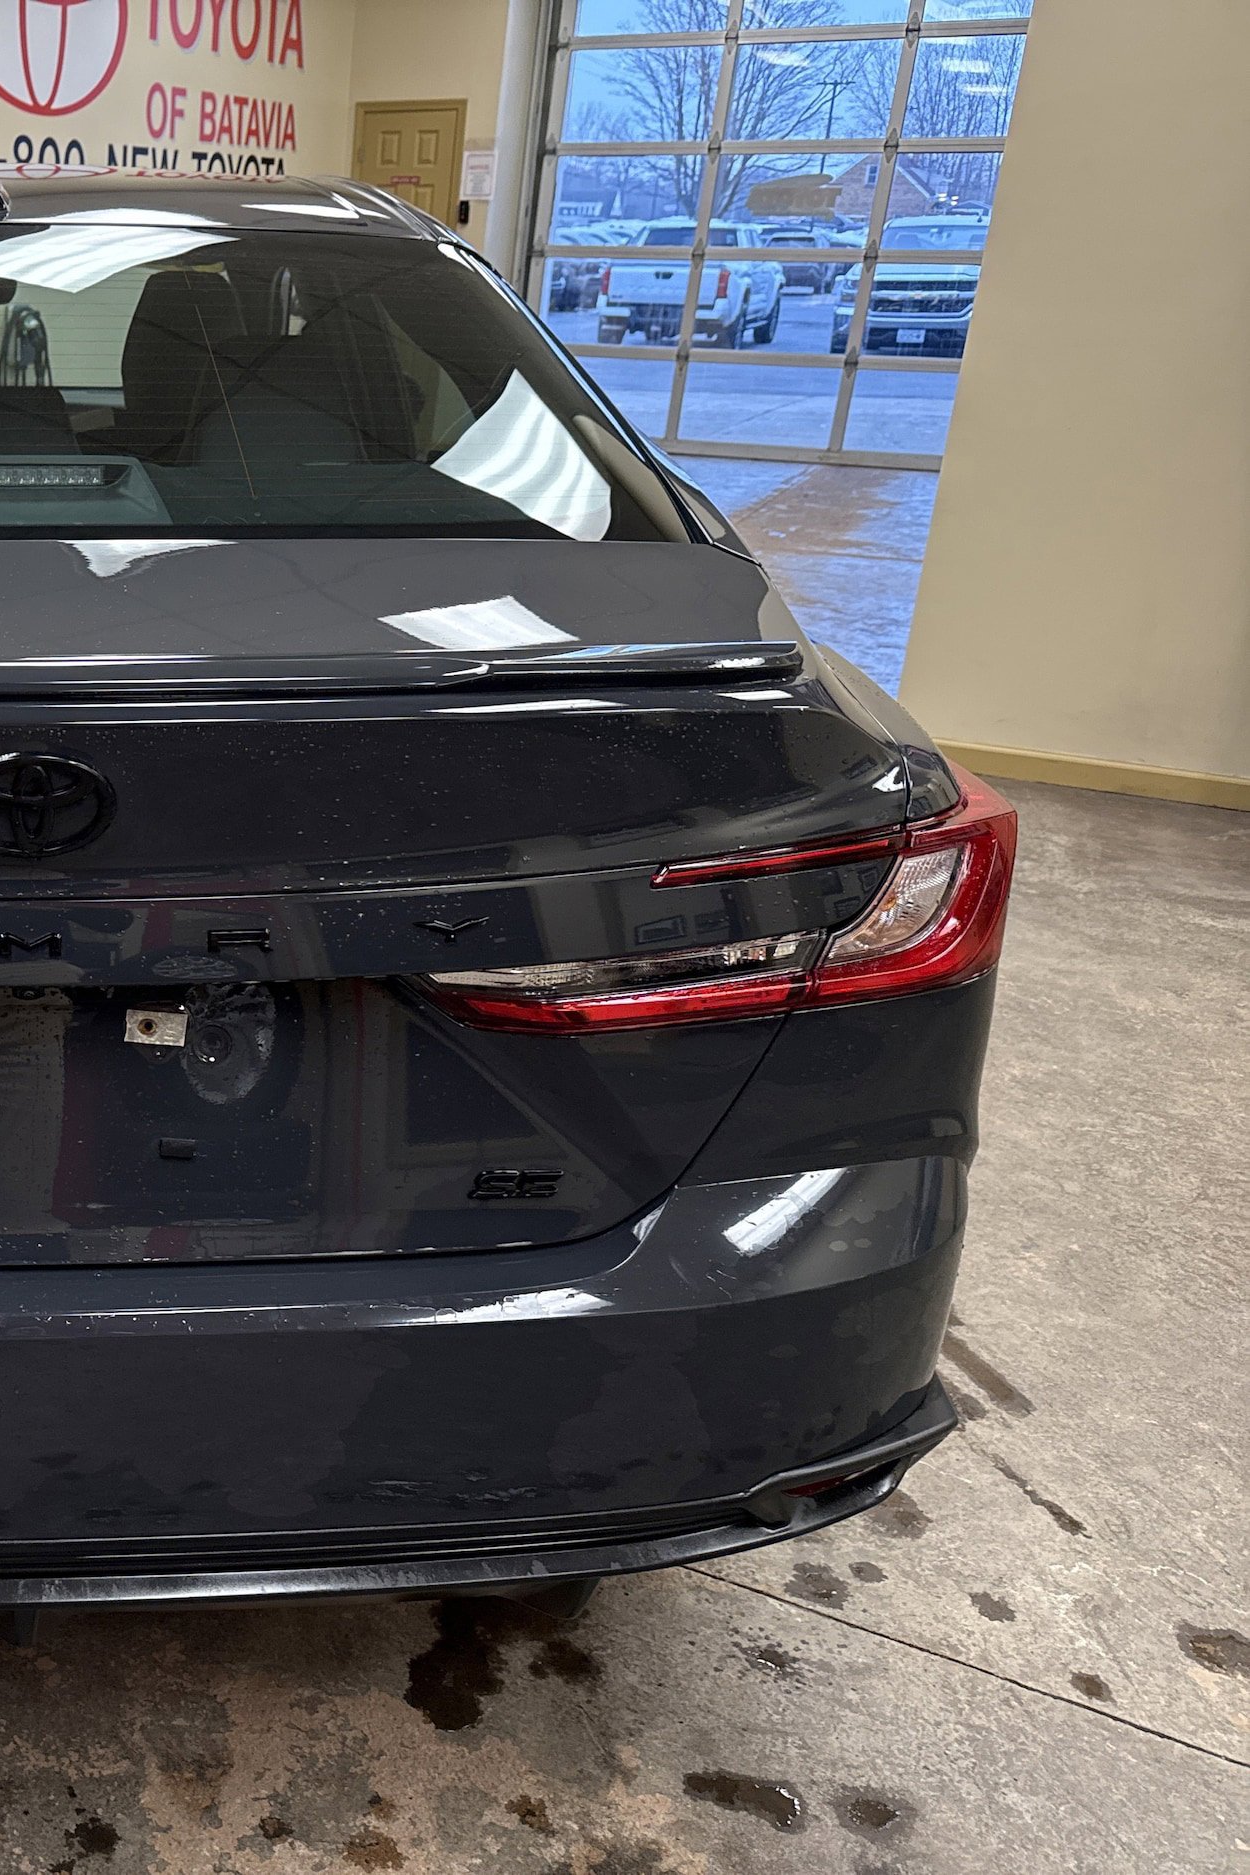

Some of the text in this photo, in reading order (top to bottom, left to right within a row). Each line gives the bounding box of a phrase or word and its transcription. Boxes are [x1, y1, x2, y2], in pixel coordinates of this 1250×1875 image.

[146, 82, 296, 151] OF BATAVIA
[467, 1168, 565, 1200] SE
